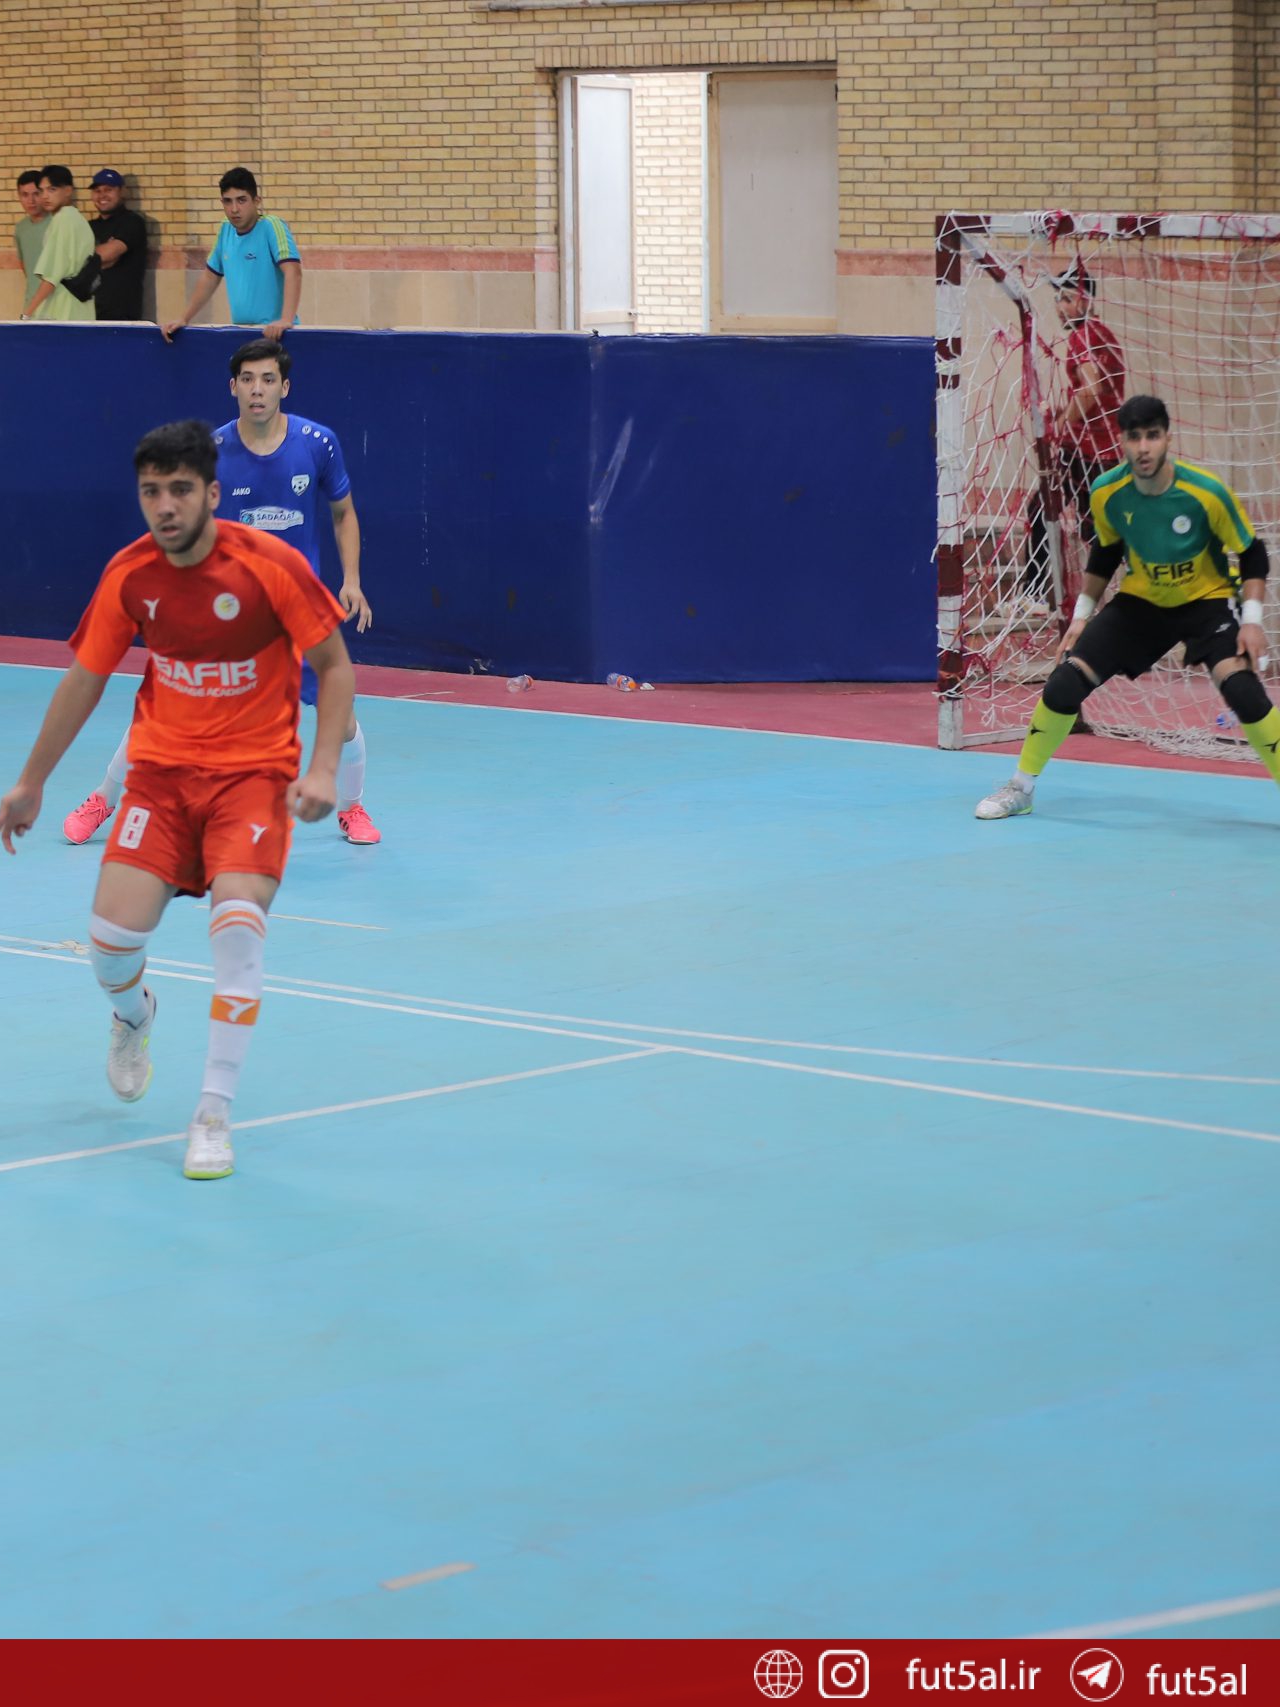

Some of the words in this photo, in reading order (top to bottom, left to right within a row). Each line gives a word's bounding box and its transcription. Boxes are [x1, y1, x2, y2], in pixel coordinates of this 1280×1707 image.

[232, 487, 251, 496] JAKO
[1142, 560, 1194, 580] FIR
[152, 652, 258, 687] SAFIR
[117, 806, 151, 849] 8
